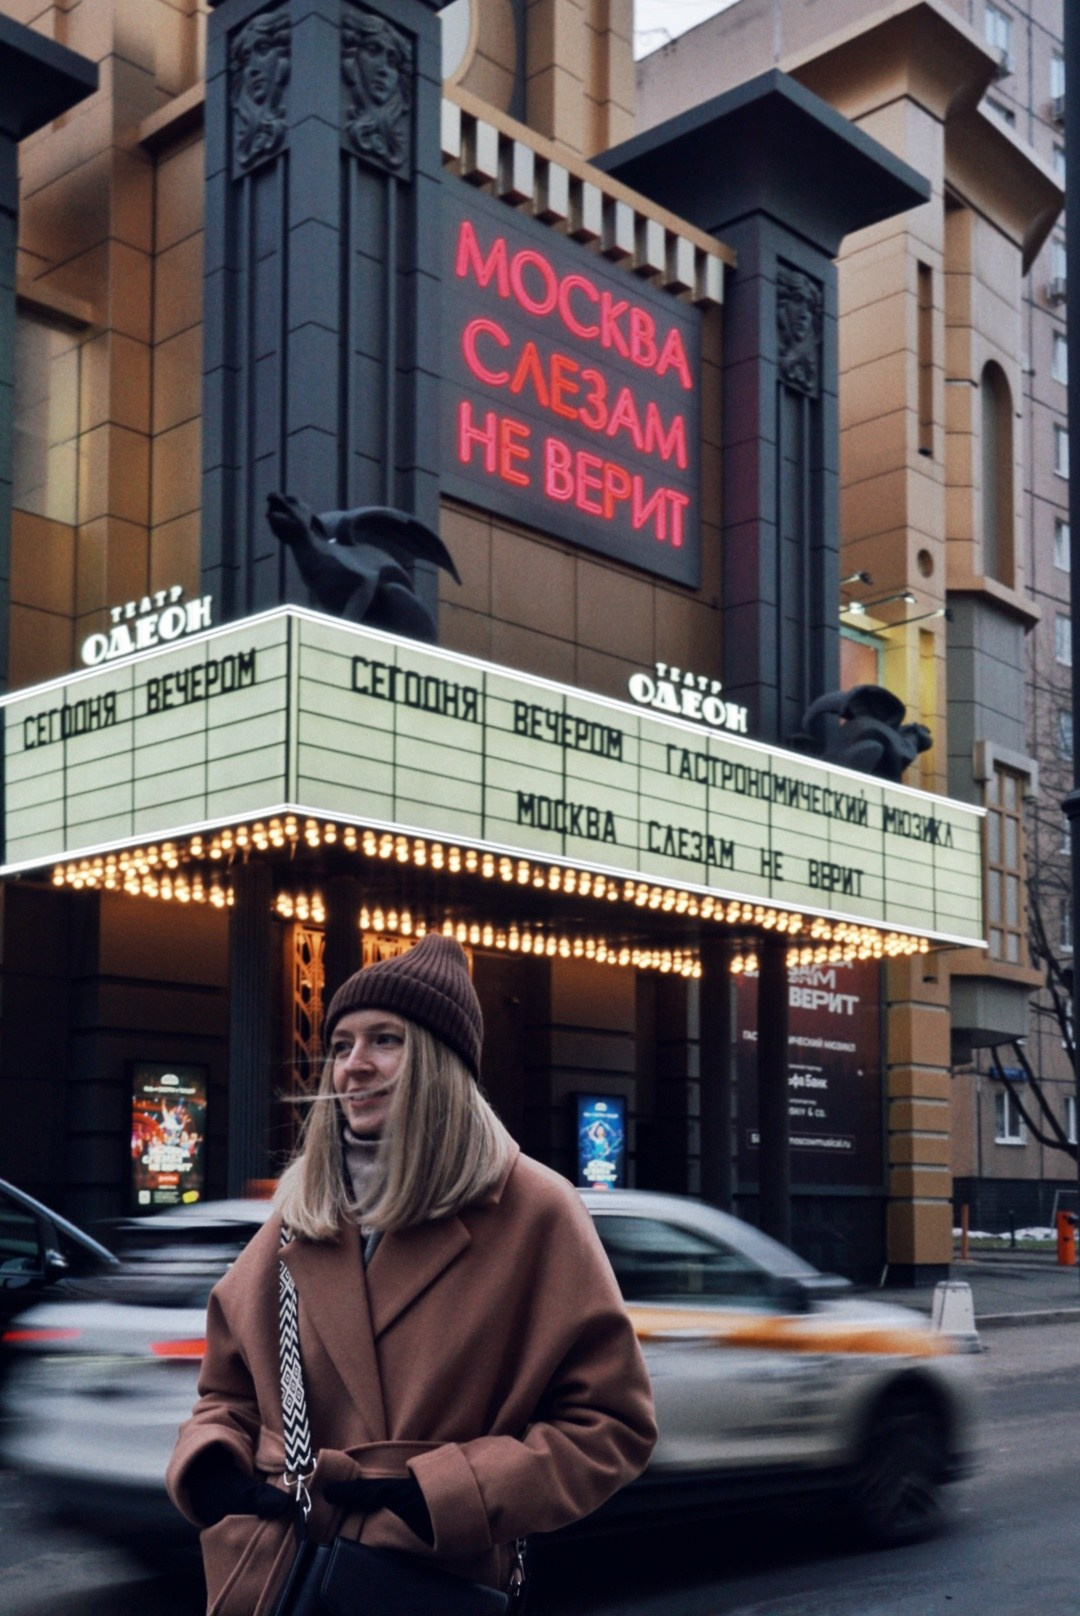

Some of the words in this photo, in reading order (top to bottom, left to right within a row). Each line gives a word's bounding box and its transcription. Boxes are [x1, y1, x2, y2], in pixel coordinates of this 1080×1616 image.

[454, 219, 693, 390] МОСКВА
[461, 317, 688, 471] СЛЕЗАМ
[457, 400, 531, 487] НЕ
[544, 436, 690, 548] ВЕРИТ
[81, 595, 213, 666] ОДЕОН
[110, 585, 183, 623] ТЕАТР
[23, 690, 117, 751] СЕГОДНЯ
[147, 647, 256, 716] ВЕЧЕРОМ
[628, 672, 748, 734] ОДЕОН
[655, 662, 723, 695] ТЕАТР
[351, 655, 479, 724] СЕГОДНЯ
[513, 699, 623, 763] ВЕЧЕРОМ
[666, 743, 869, 828] ГАСТРОНОМИЧЕСКИЙ
[882, 803, 954, 849] МЮЗИКЛ
[516, 789, 618, 845] МОСКВА
[648, 820, 735, 871] СЛЕЗАМ
[760, 848, 785, 882] НЕ
[808, 858, 865, 898] ВЕРИТ
[788, 985, 860, 1016] ВЕРИТ
